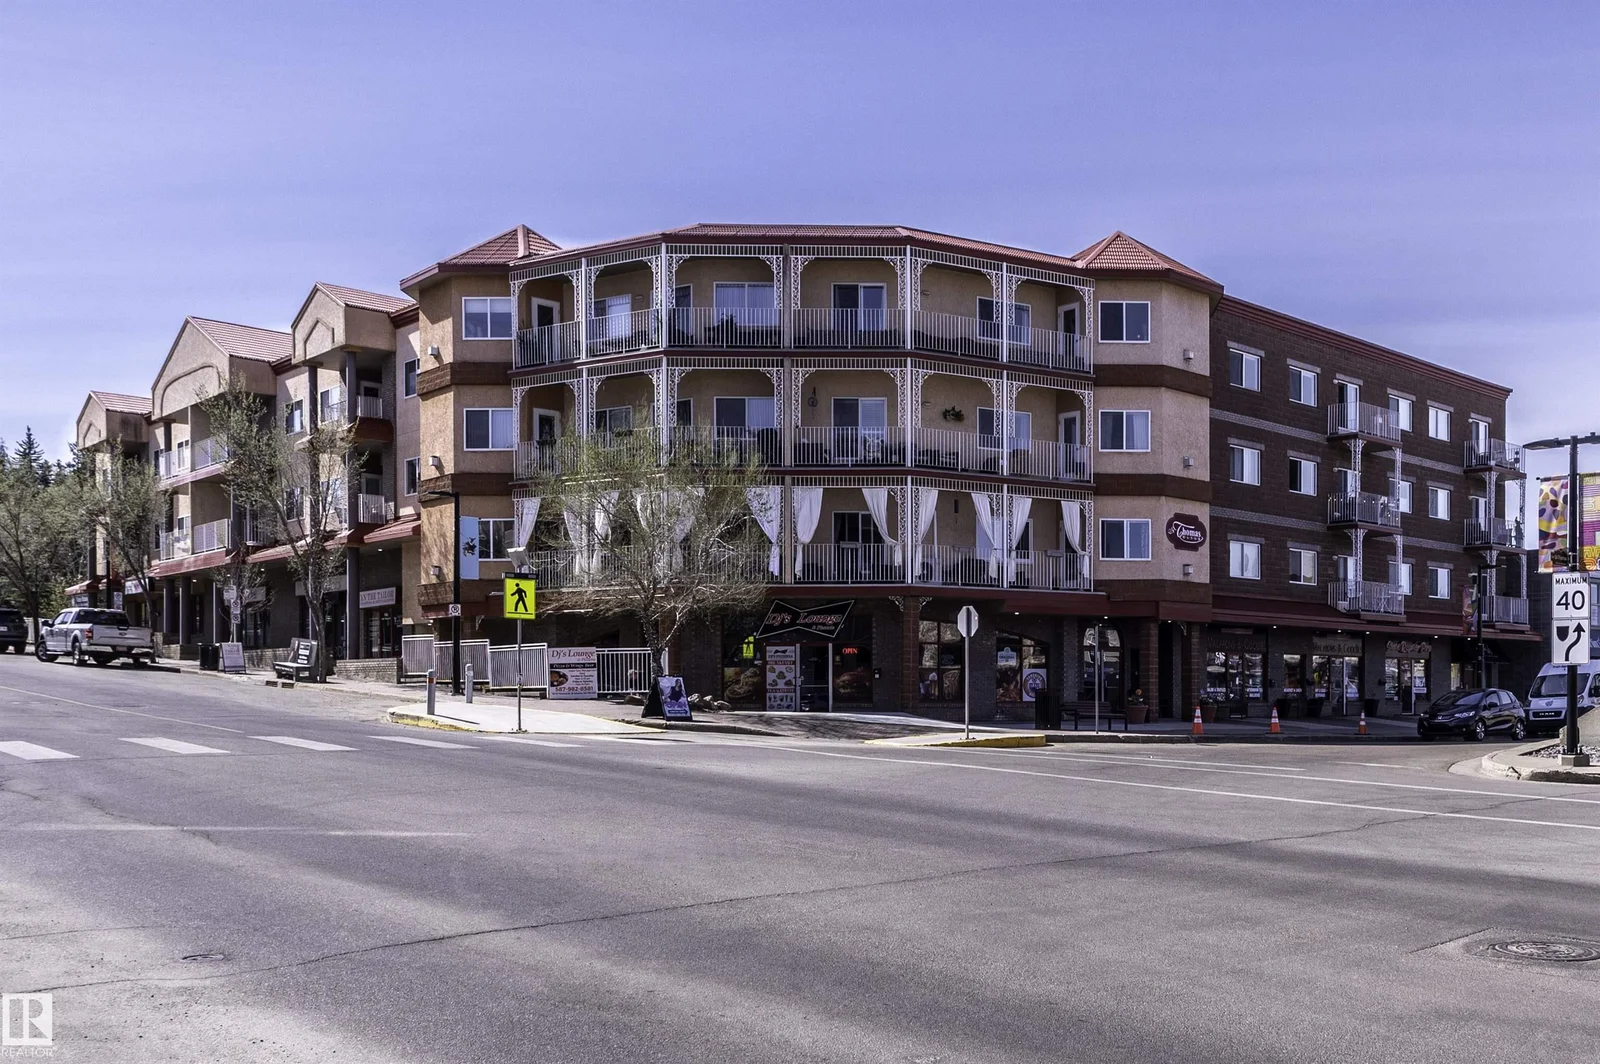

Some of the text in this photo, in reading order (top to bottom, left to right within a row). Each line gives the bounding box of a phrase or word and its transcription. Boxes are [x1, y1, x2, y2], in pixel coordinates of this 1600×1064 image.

[1173, 521, 1203, 542] Thomas
[1555, 577, 1587, 585] MAXIMUM
[1556, 590, 1585, 610] 40
[796, 612, 843, 625] Lounge
[568, 649, 595, 659] Lounge
